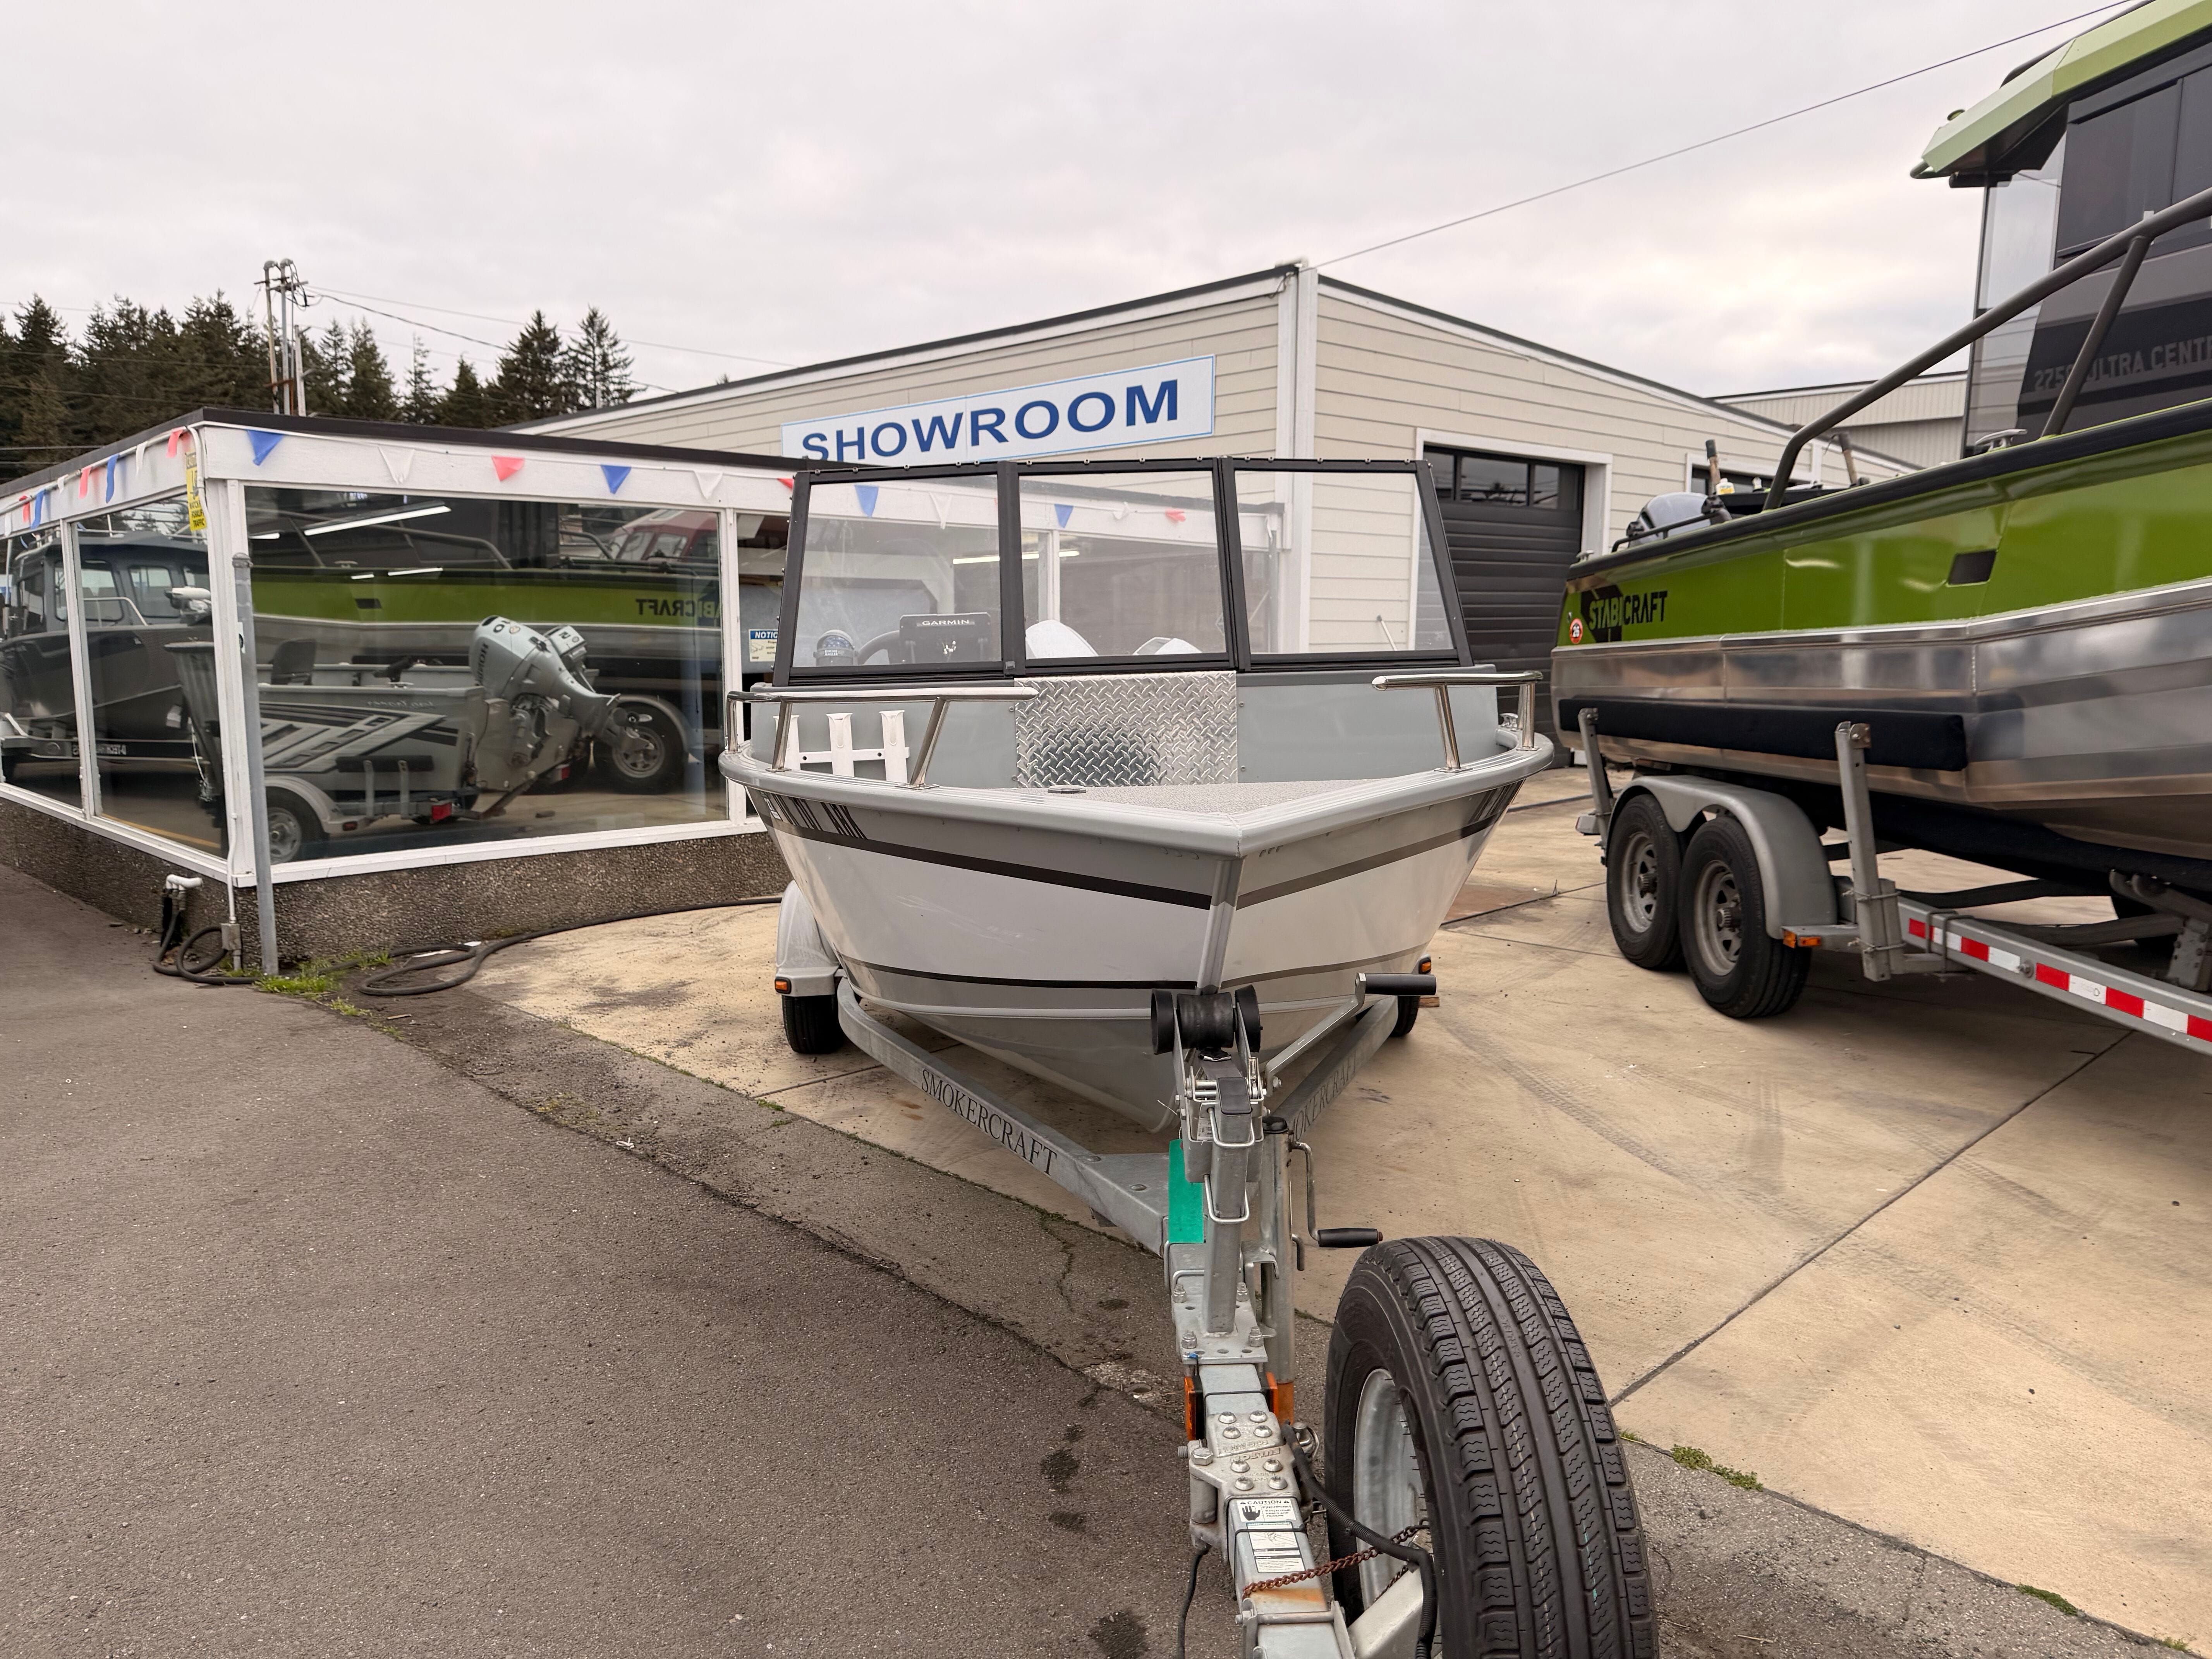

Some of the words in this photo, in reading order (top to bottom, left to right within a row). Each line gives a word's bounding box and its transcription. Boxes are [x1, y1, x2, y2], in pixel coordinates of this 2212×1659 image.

[802, 380, 1177, 461] SHOWROOM
[1589, 591, 1668, 630] STABICRAFT
[922, 1069, 1057, 1176] SMOKERCRAFT
